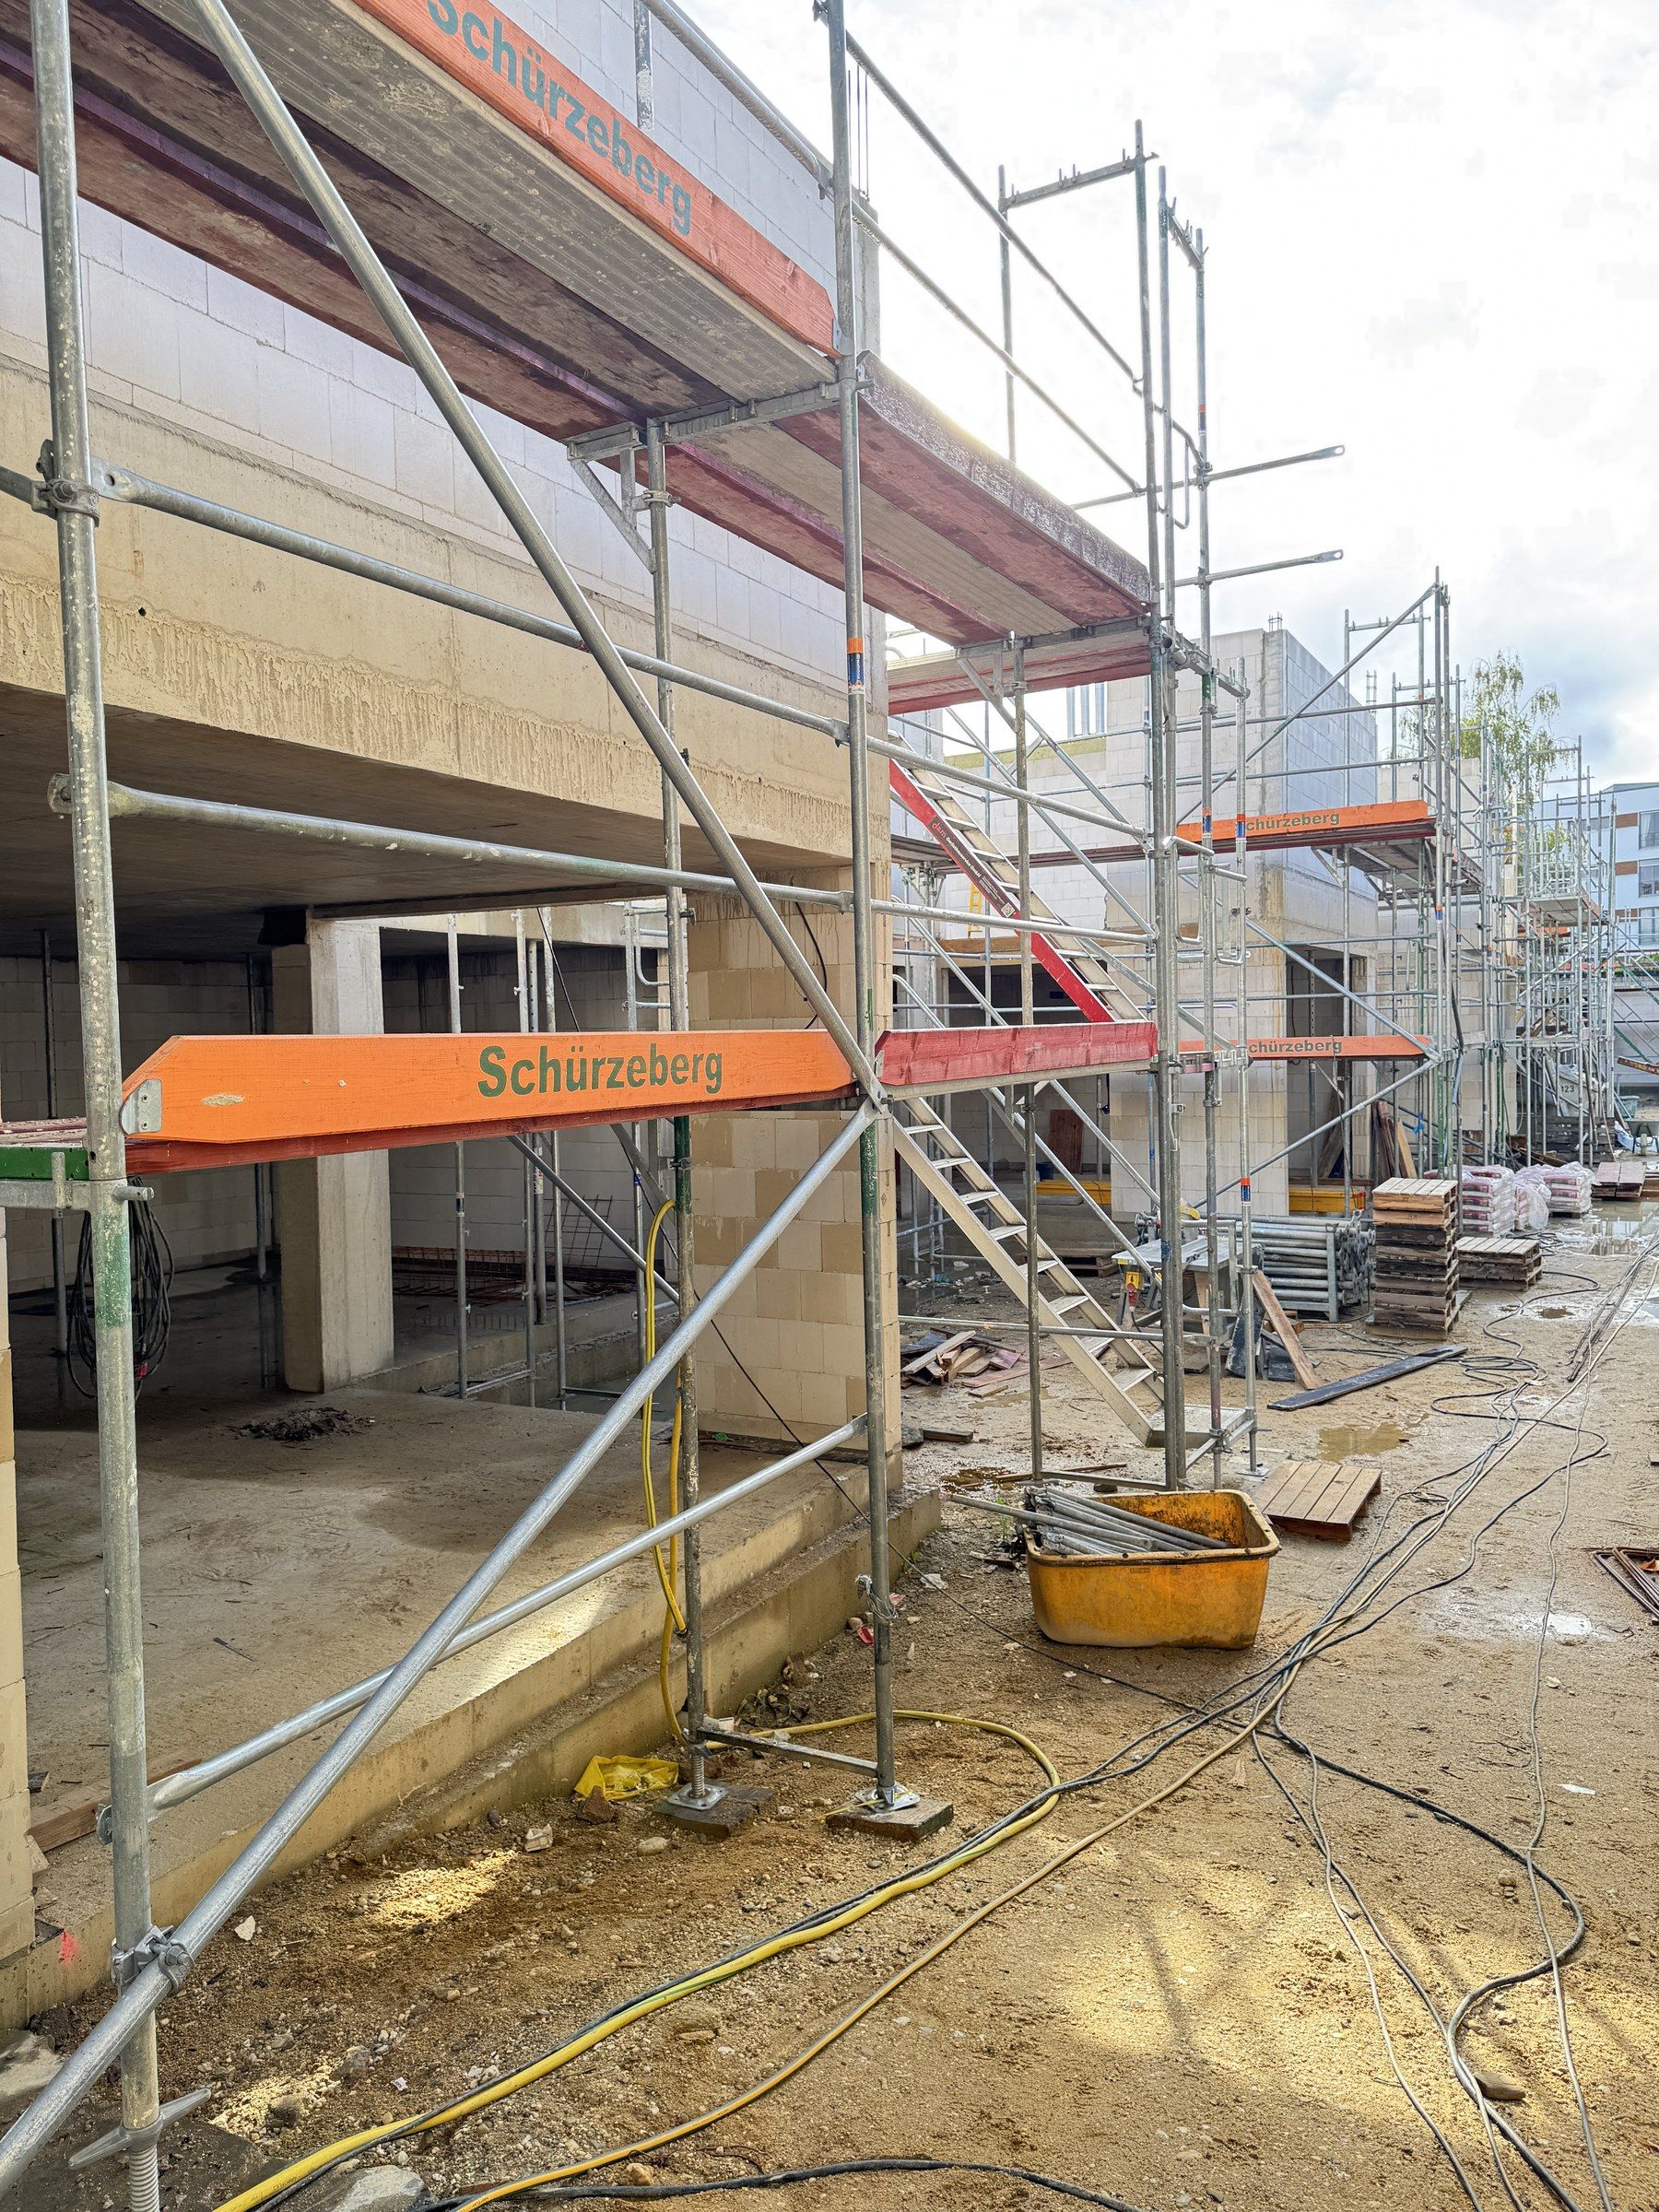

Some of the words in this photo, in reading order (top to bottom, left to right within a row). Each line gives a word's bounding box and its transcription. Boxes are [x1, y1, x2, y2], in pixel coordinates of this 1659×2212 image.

[1245, 812, 1340, 831] chürzeberg
[1248, 1040, 1342, 1054] chürzeberg
[477, 1042, 723, 1098] Schürzeberg
